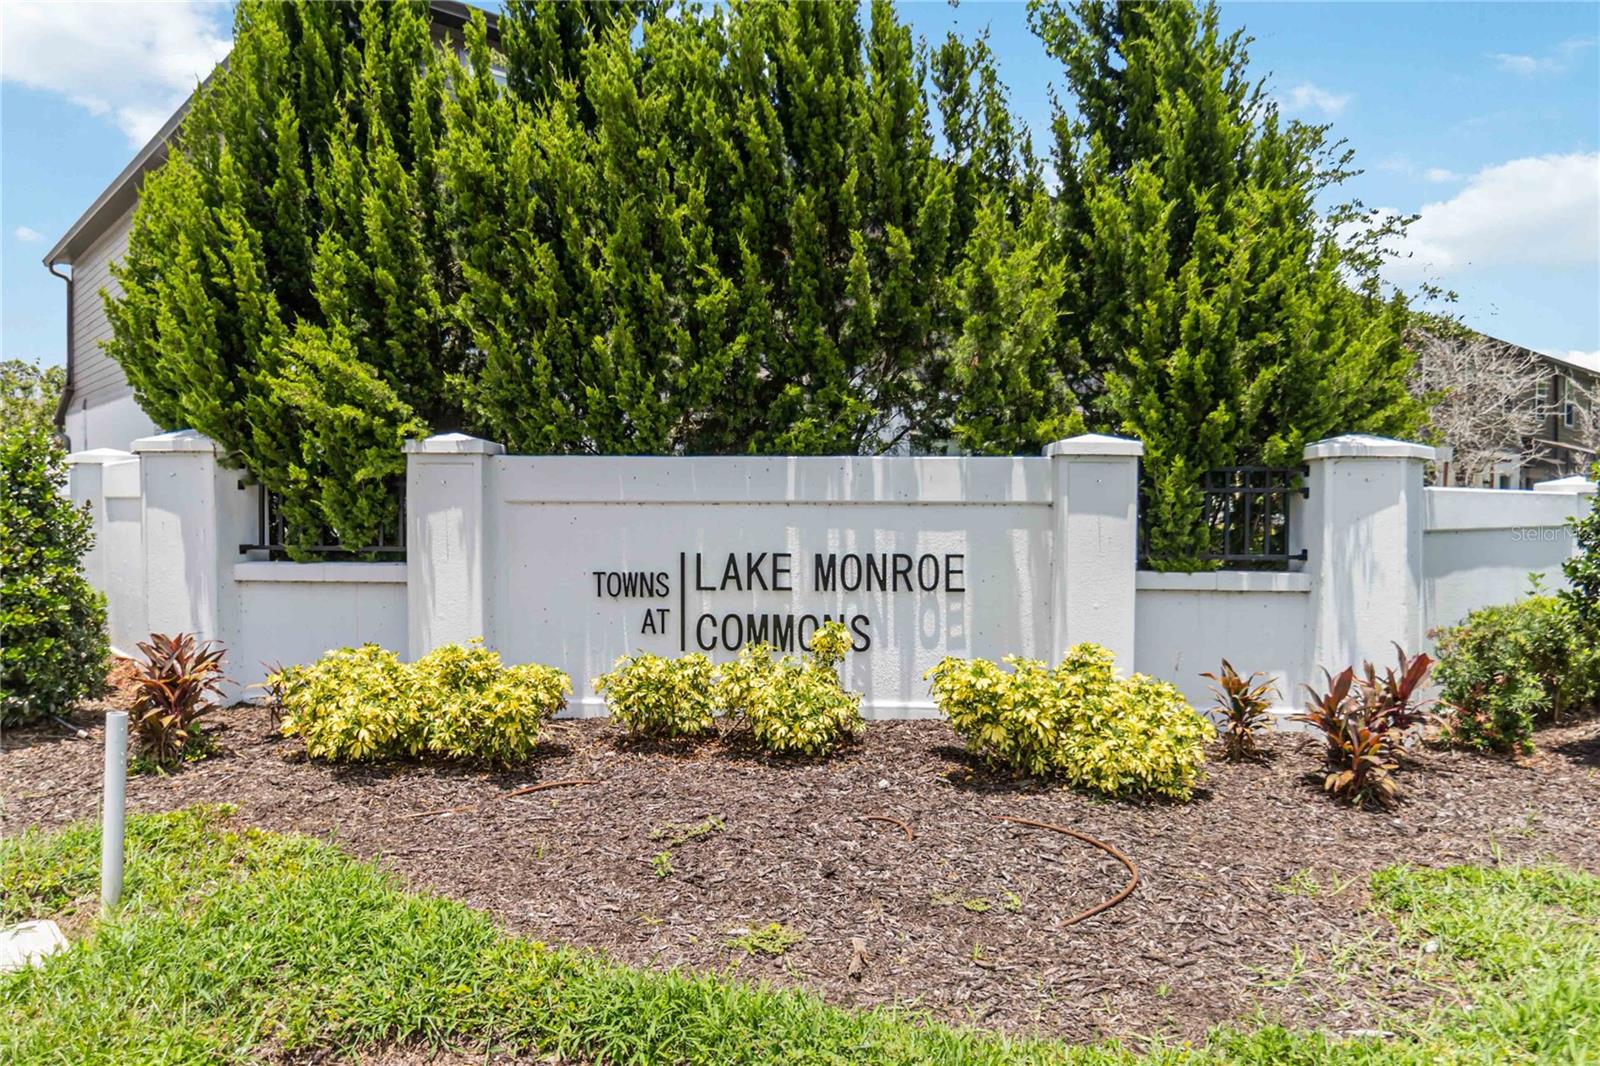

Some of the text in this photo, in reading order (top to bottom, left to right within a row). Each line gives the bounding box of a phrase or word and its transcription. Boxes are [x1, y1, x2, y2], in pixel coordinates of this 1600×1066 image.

[592, 571, 670, 598] TOWNS
[696, 552, 966, 593] LAKE MONROE
[641, 608, 670, 635] AT
